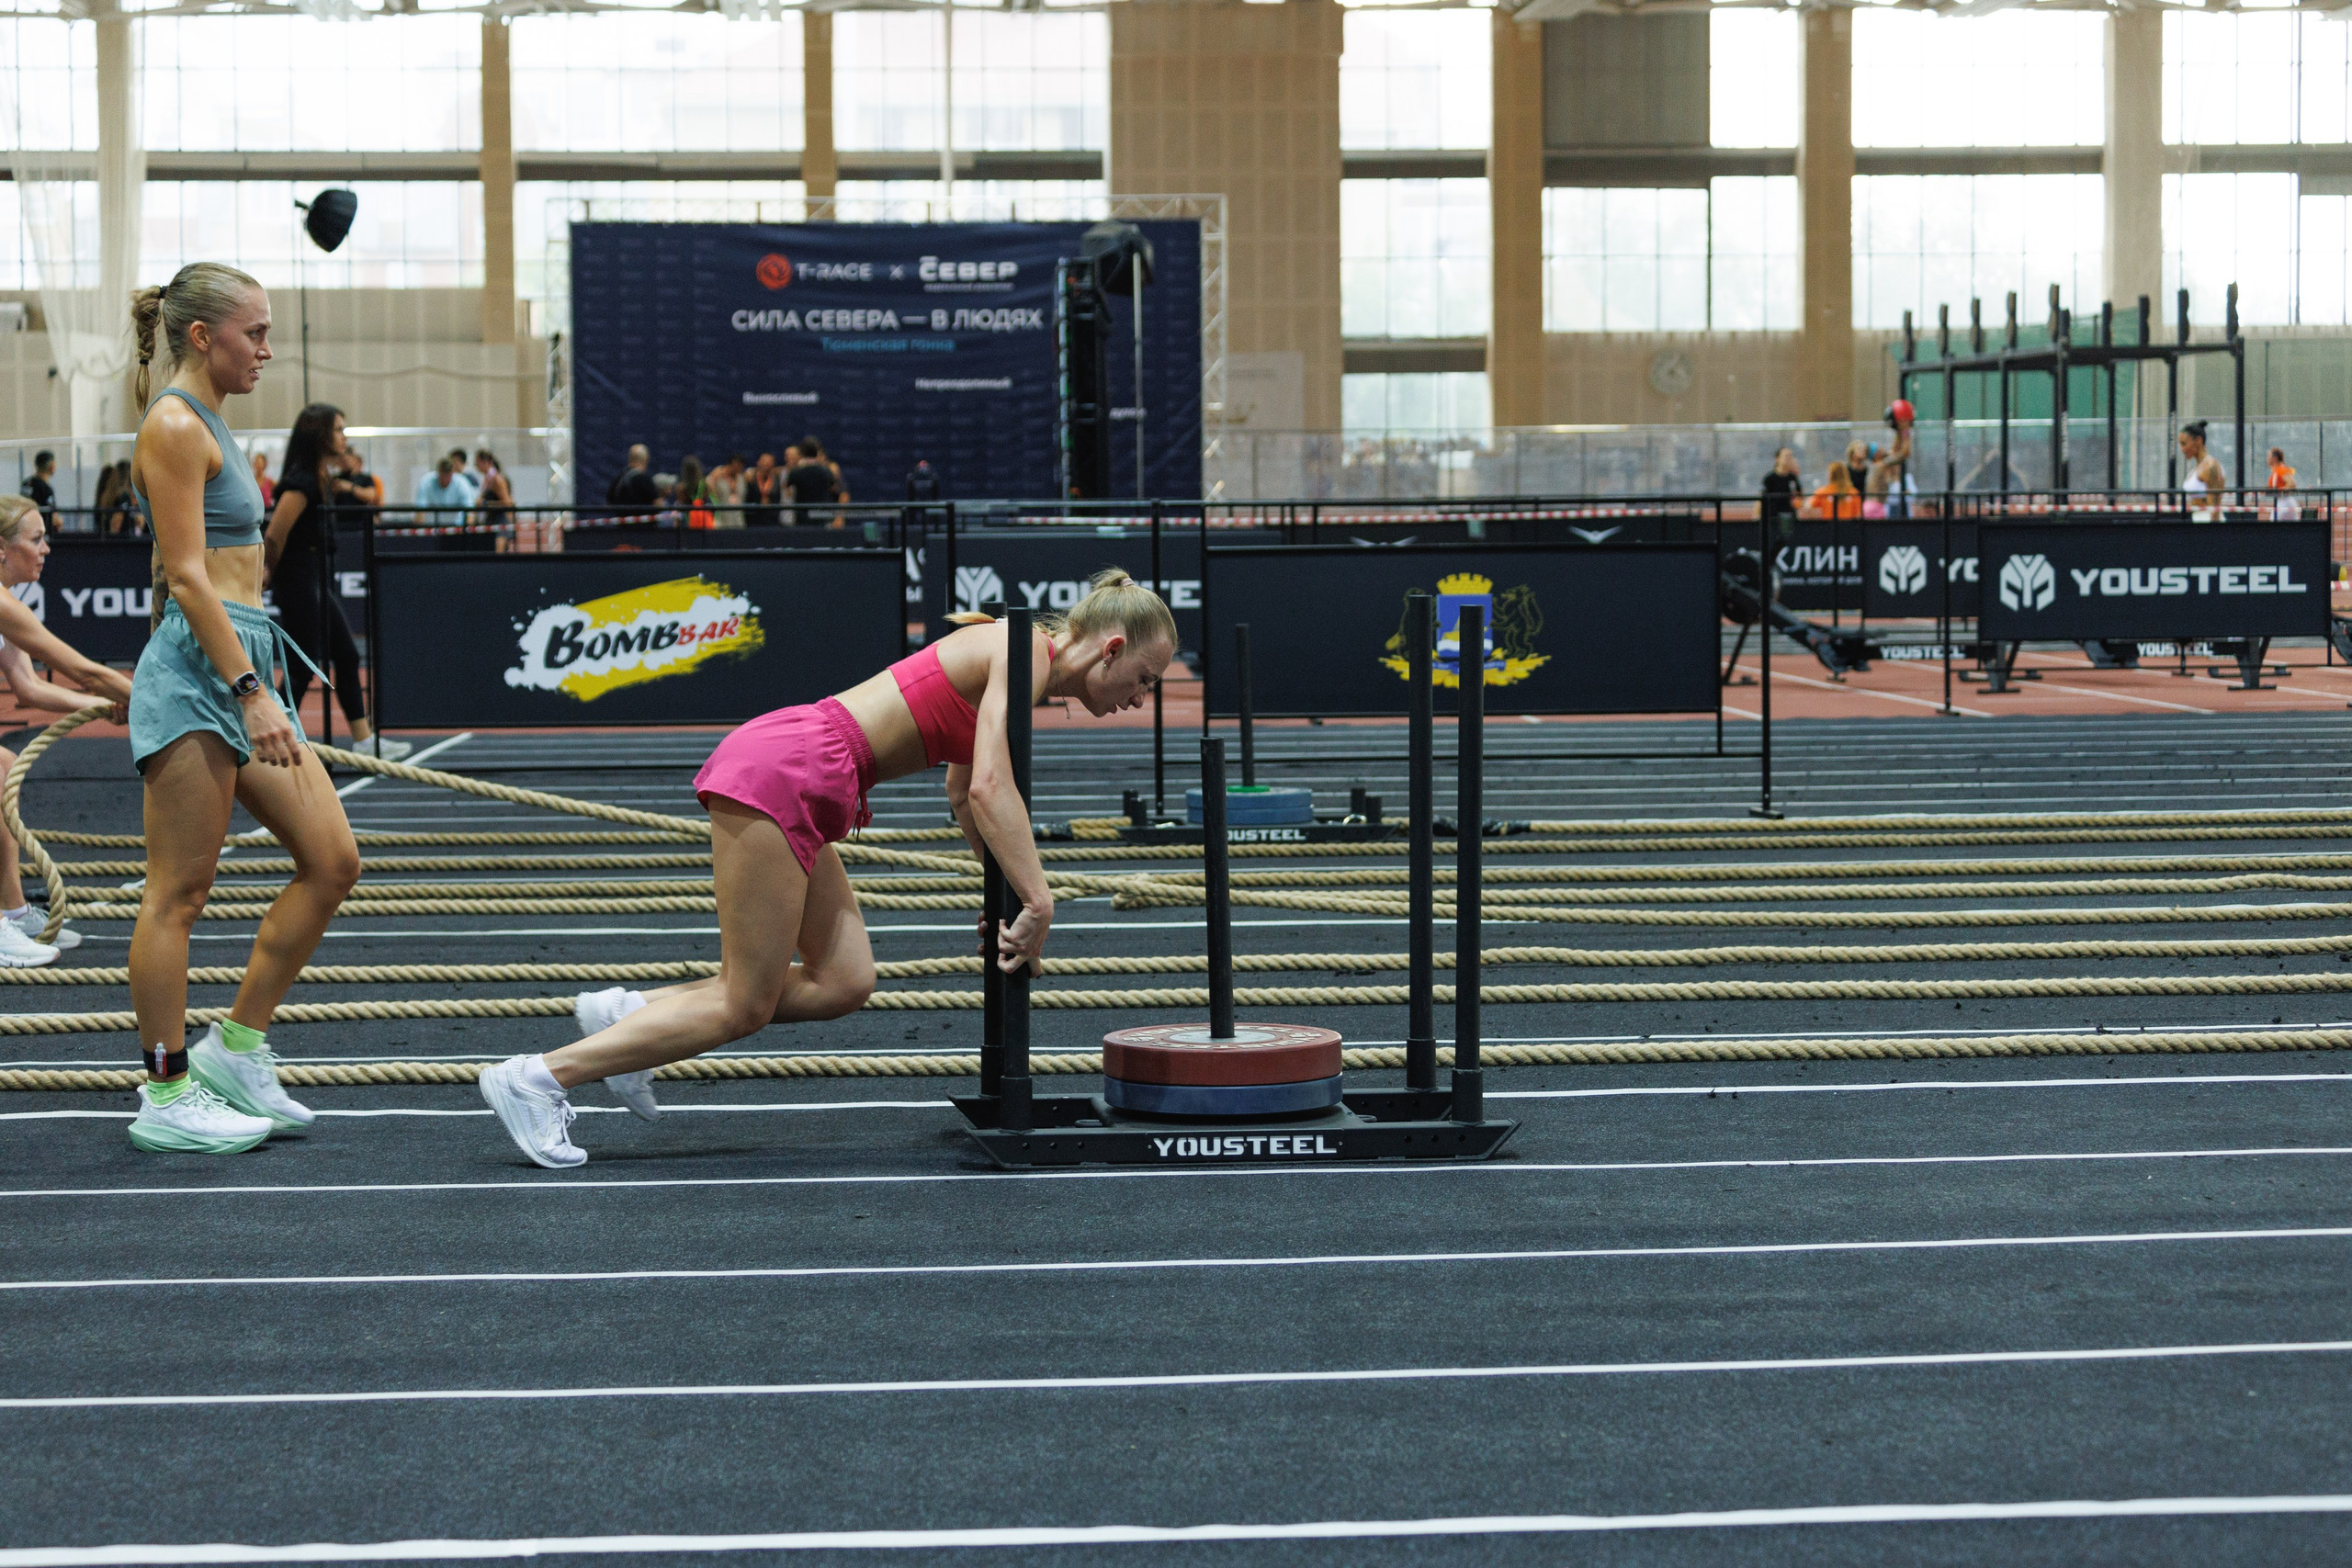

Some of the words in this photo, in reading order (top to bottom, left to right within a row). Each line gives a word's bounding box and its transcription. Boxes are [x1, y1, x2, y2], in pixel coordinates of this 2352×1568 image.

[731, 309, 805, 333] СИЛА
[805, 309, 902, 333] СЕВЕРА
[931, 309, 950, 332] В
[952, 308, 1045, 334] ЛЮДЯХ
[2070, 565, 2307, 597] YOUSTEEL
[1153, 1135, 1338, 1157] YOUSTEEL
